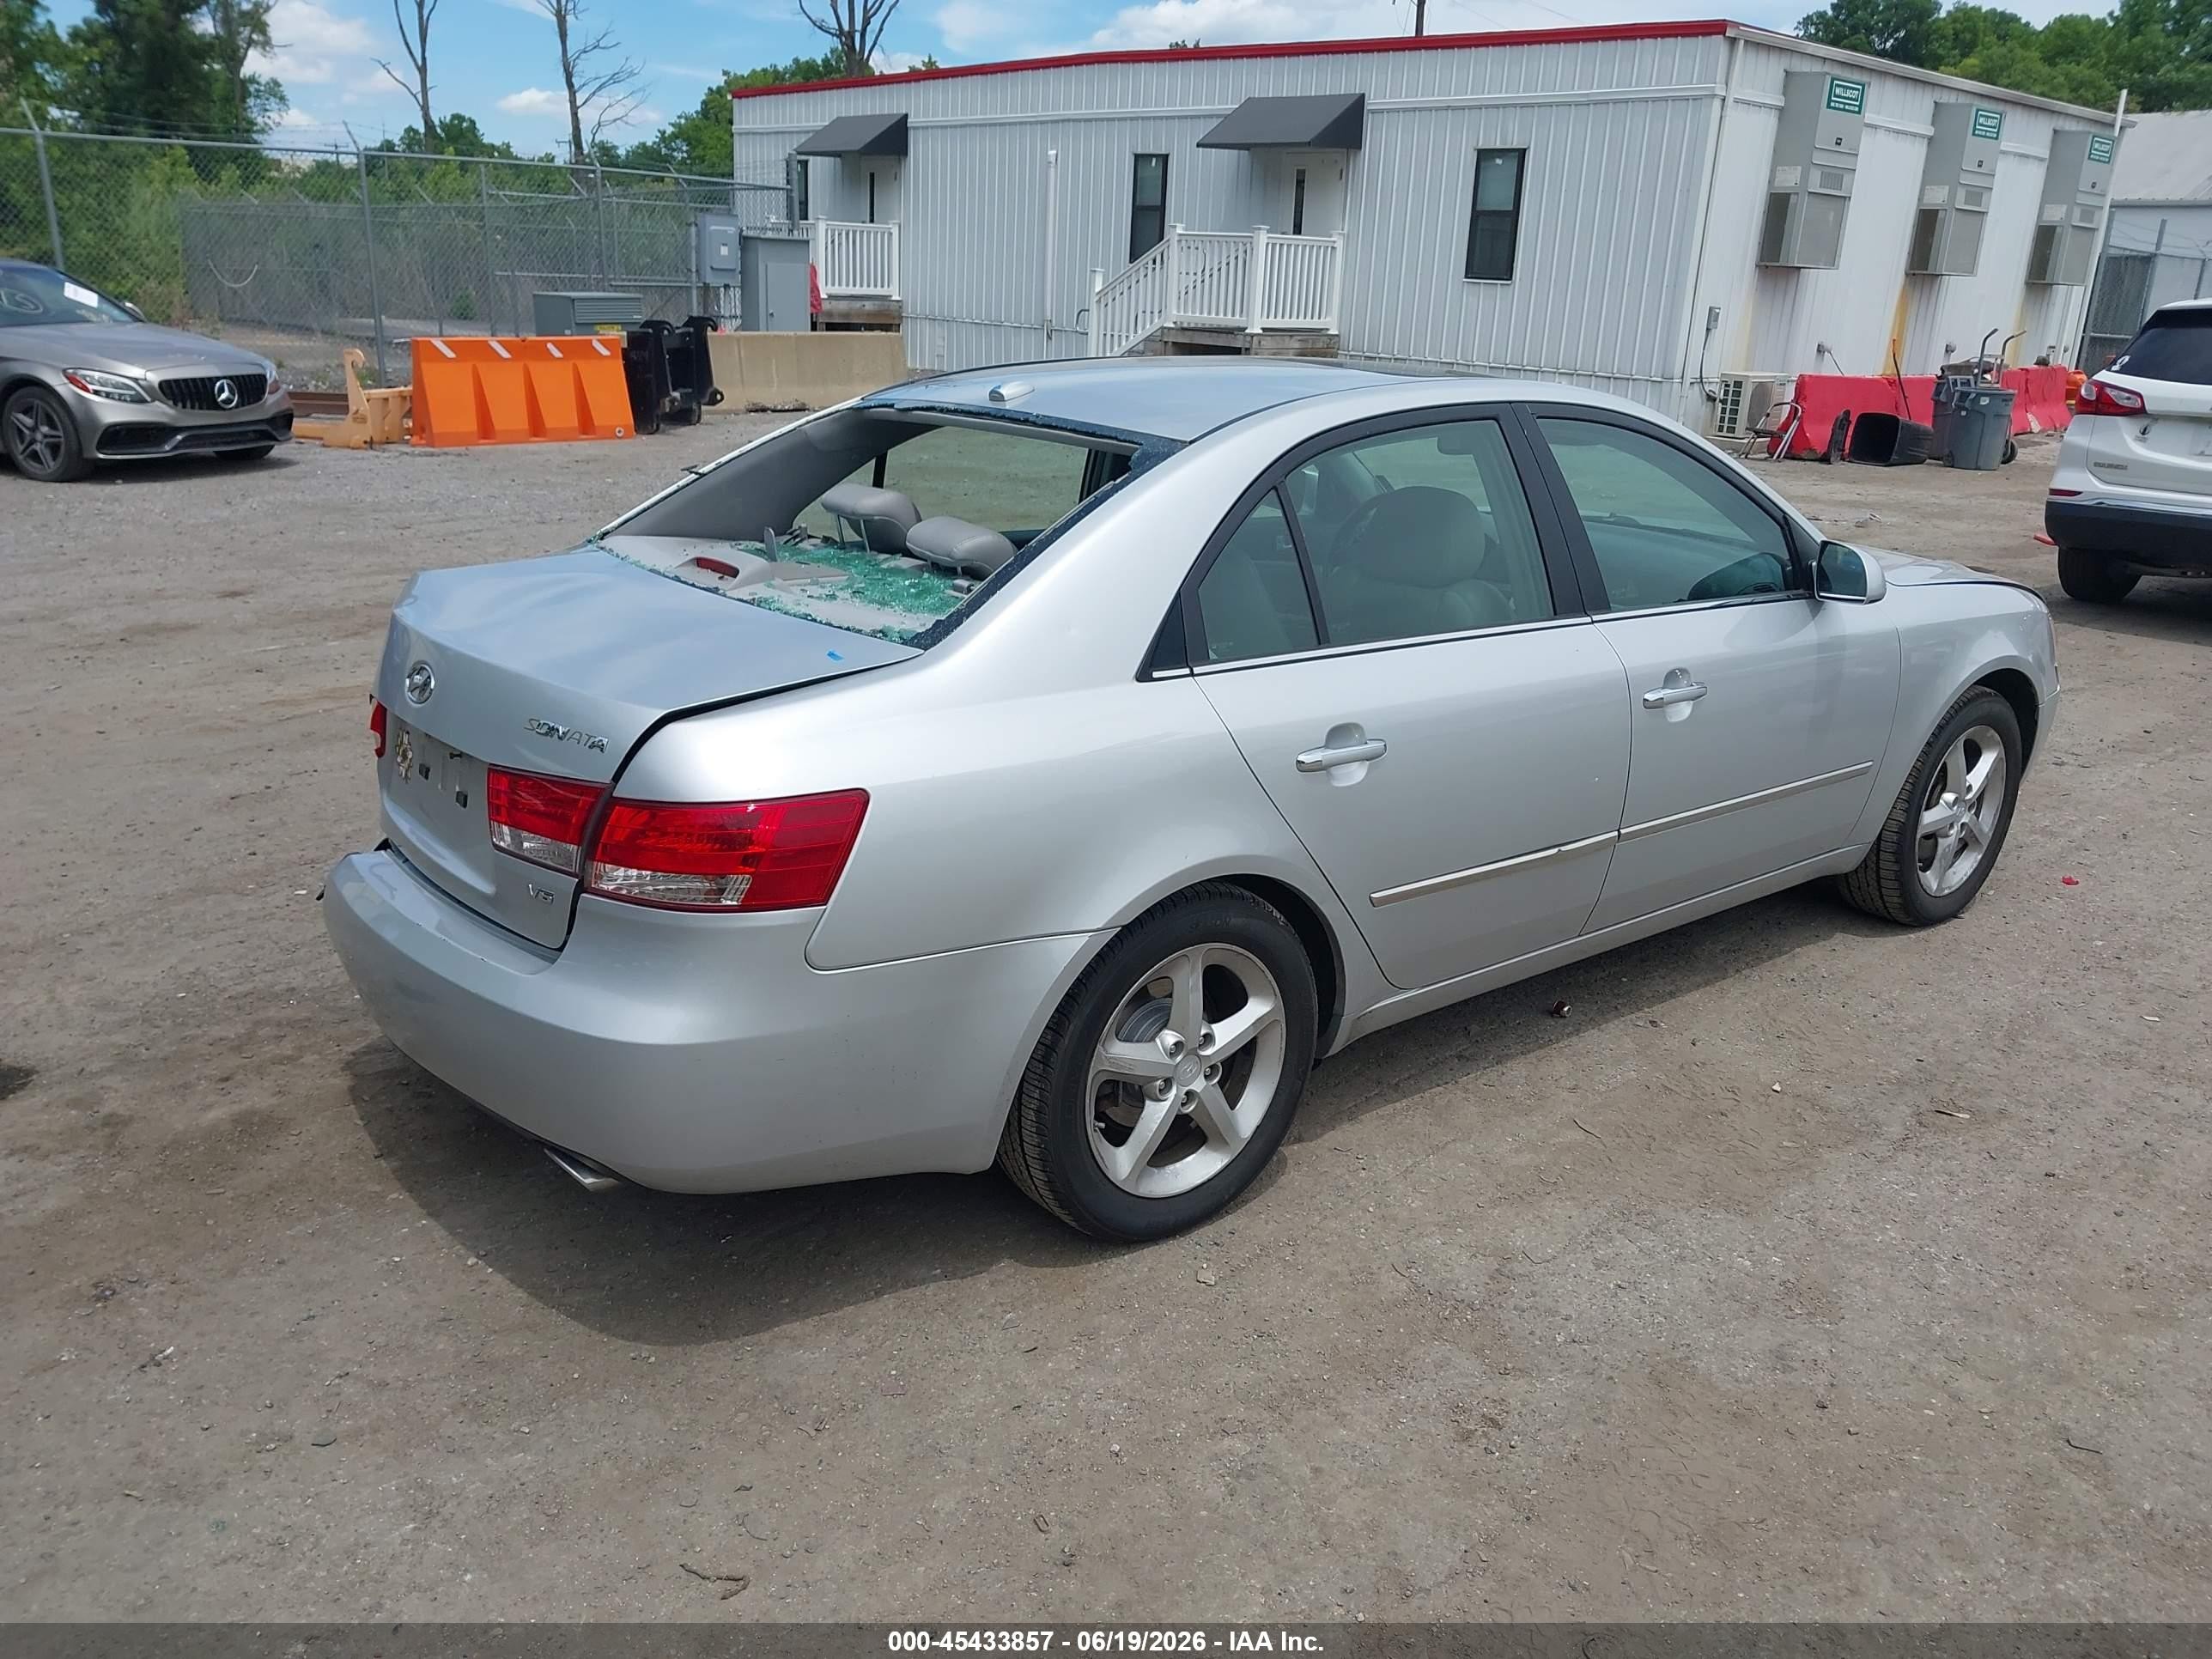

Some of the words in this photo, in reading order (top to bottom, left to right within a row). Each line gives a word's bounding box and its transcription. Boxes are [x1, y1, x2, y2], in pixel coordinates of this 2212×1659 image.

[1835, 86, 1859, 100] WILLSCOT
[524, 718, 609, 754] SONATA
[528, 884, 555, 904] V6
